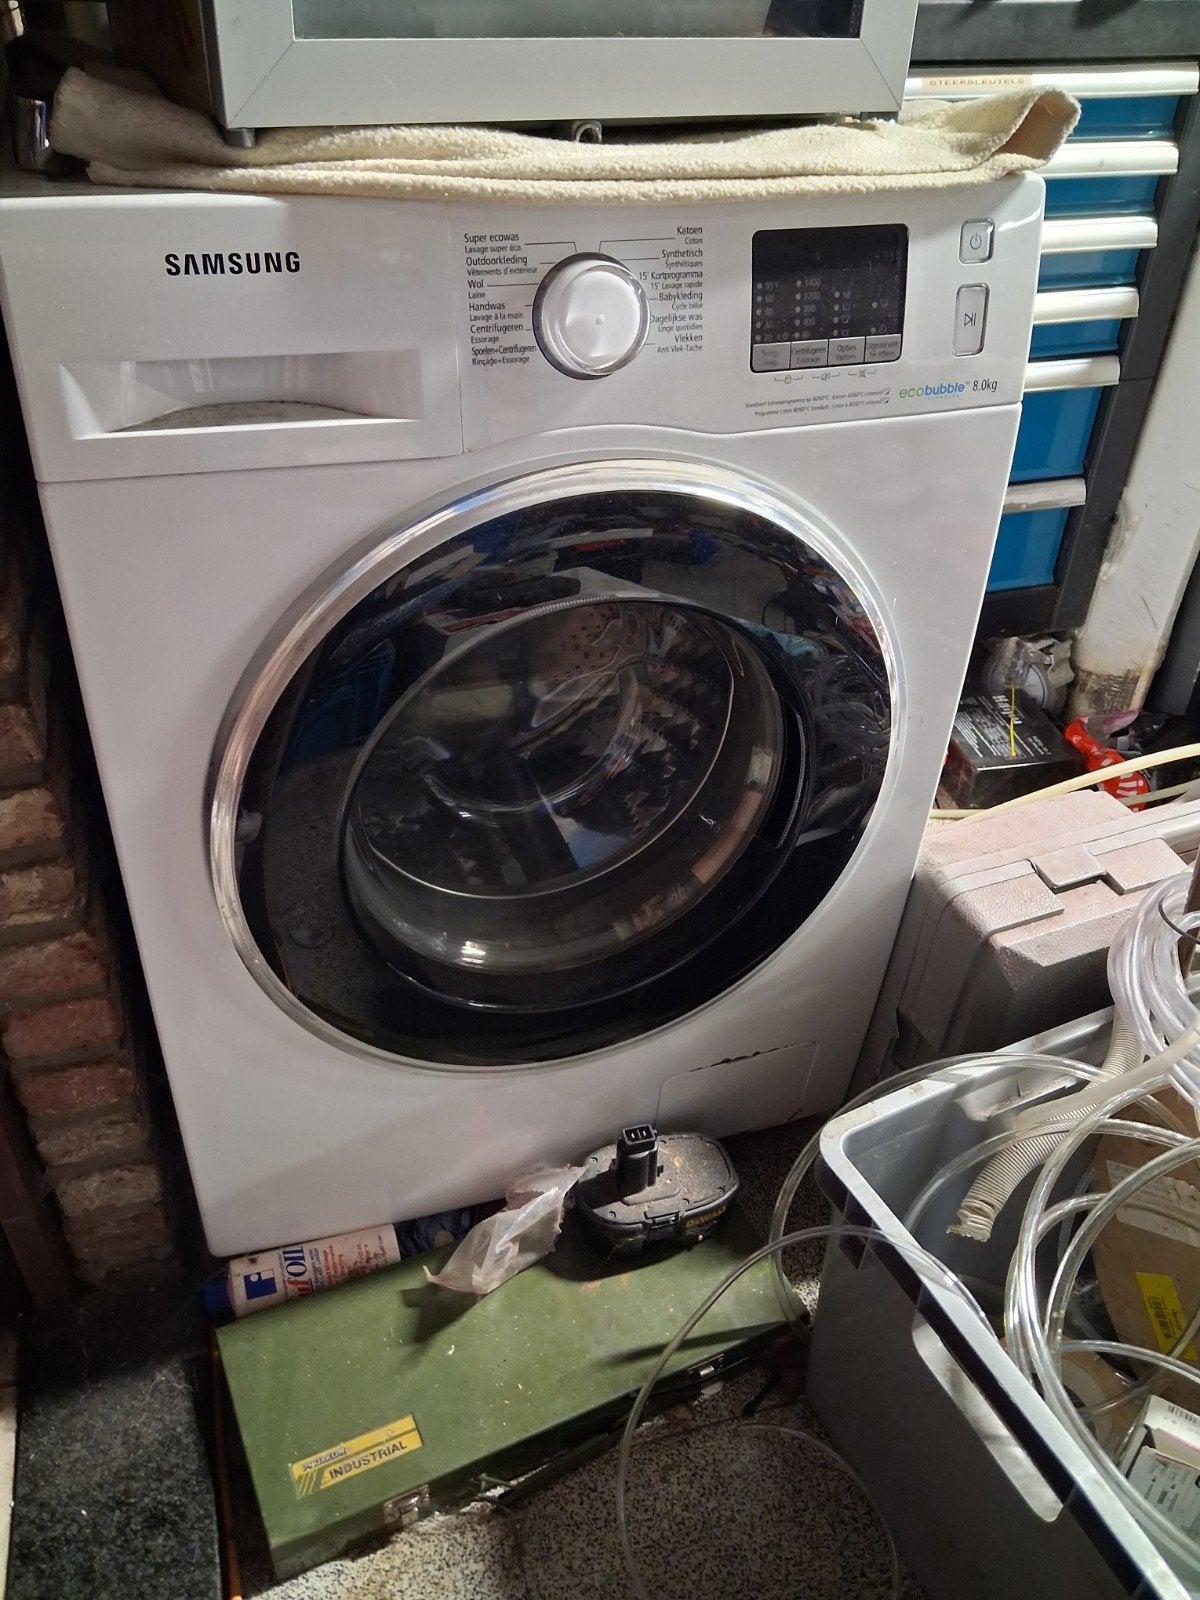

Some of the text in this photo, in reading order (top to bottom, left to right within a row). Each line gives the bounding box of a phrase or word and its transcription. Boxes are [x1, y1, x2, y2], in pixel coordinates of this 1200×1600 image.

[929, 78, 1025, 86] STEEKSLEUTELS
[676, 226, 703, 235] Katoen
[464, 233, 520, 245] Super ecowas
[464, 245, 488, 254] Lavage
[489, 245, 508, 253] super
[661, 248, 703, 260] Synthetisch
[164, 251, 300, 276] SAMSUNG
[466, 256, 528, 267] Outdoorkleding
[651, 270, 703, 281] Kortprogramma
[467, 279, 484, 289] Wol
[662, 281, 683, 291] Lavage
[684, 280, 703, 289] rapide
[468, 291, 486, 299] Laine
[658, 291, 703, 302] Babykleding
[468, 301, 506, 312] Handwas
[671, 302, 688, 311] Cycle
[469, 313, 493, 322] Lavage
[650, 313, 687, 325] Dagelijkse
[470, 322, 524, 335] Centrifugeren
[657, 323, 703, 333] Linge quotidien
[470, 336, 500, 344] Essorage
[674, 333, 703, 342] Vlekken
[972, 378, 998, 392] 8.0kg
[328, 1440, 408, 1480] INDUSTRIAL
